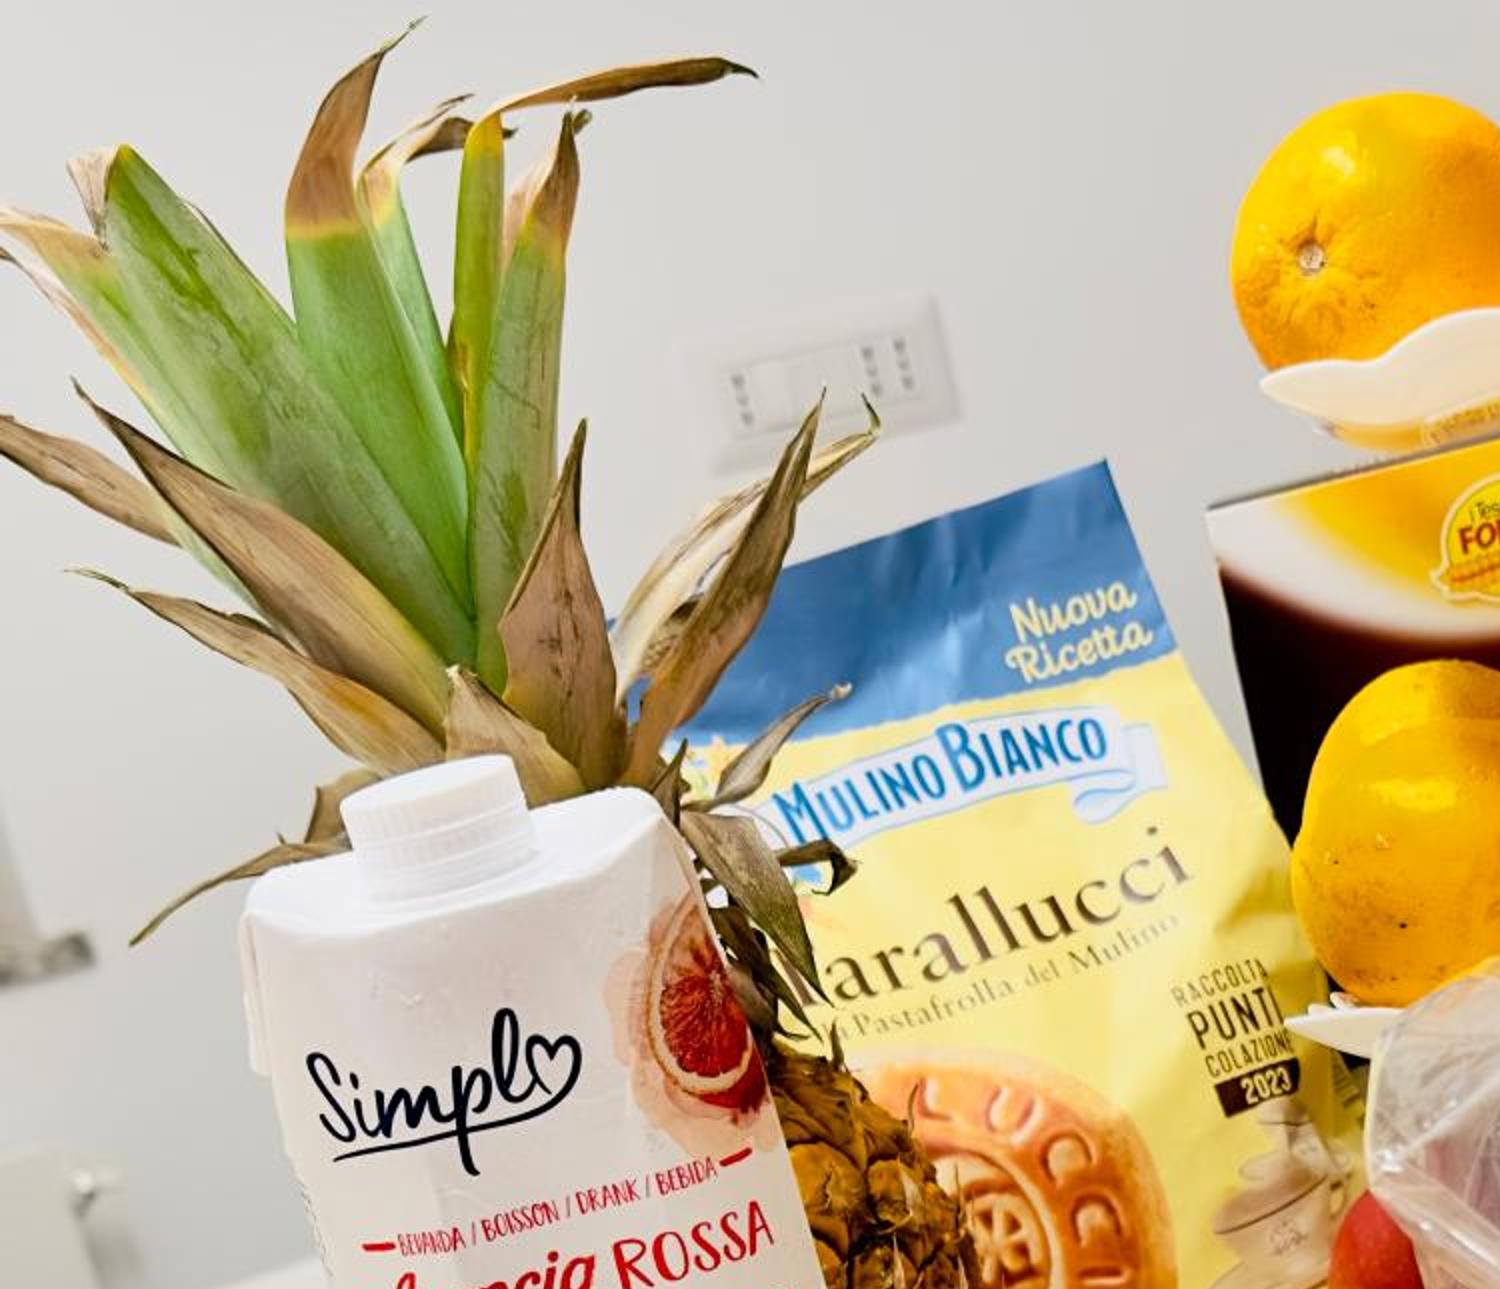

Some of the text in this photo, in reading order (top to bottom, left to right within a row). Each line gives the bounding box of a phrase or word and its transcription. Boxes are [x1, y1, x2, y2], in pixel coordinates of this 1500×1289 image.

[1008, 579, 1139, 645] Nuova
[1003, 620, 1155, 685] Ricetta
[772, 715, 1109, 849] MULINO BIANCO
[852, 976, 1017, 1038] Pastafrolla
[1022, 959, 1062, 989] del
[1066, 913, 1182, 979] Mulino
[1170, 957, 1269, 1009] RACCOLTA
[1185, 985, 1286, 1051] PUNTI
[1204, 1027, 1295, 1079] COLAZIONE
[1239, 1065, 1293, 1106] 2023
[396, 1229, 465, 1258] BEVANDA
[481, 1198, 561, 1243] BOISSON
[575, 1178, 640, 1216] DRANK
[656, 1155, 720, 1197] BEBIDA
